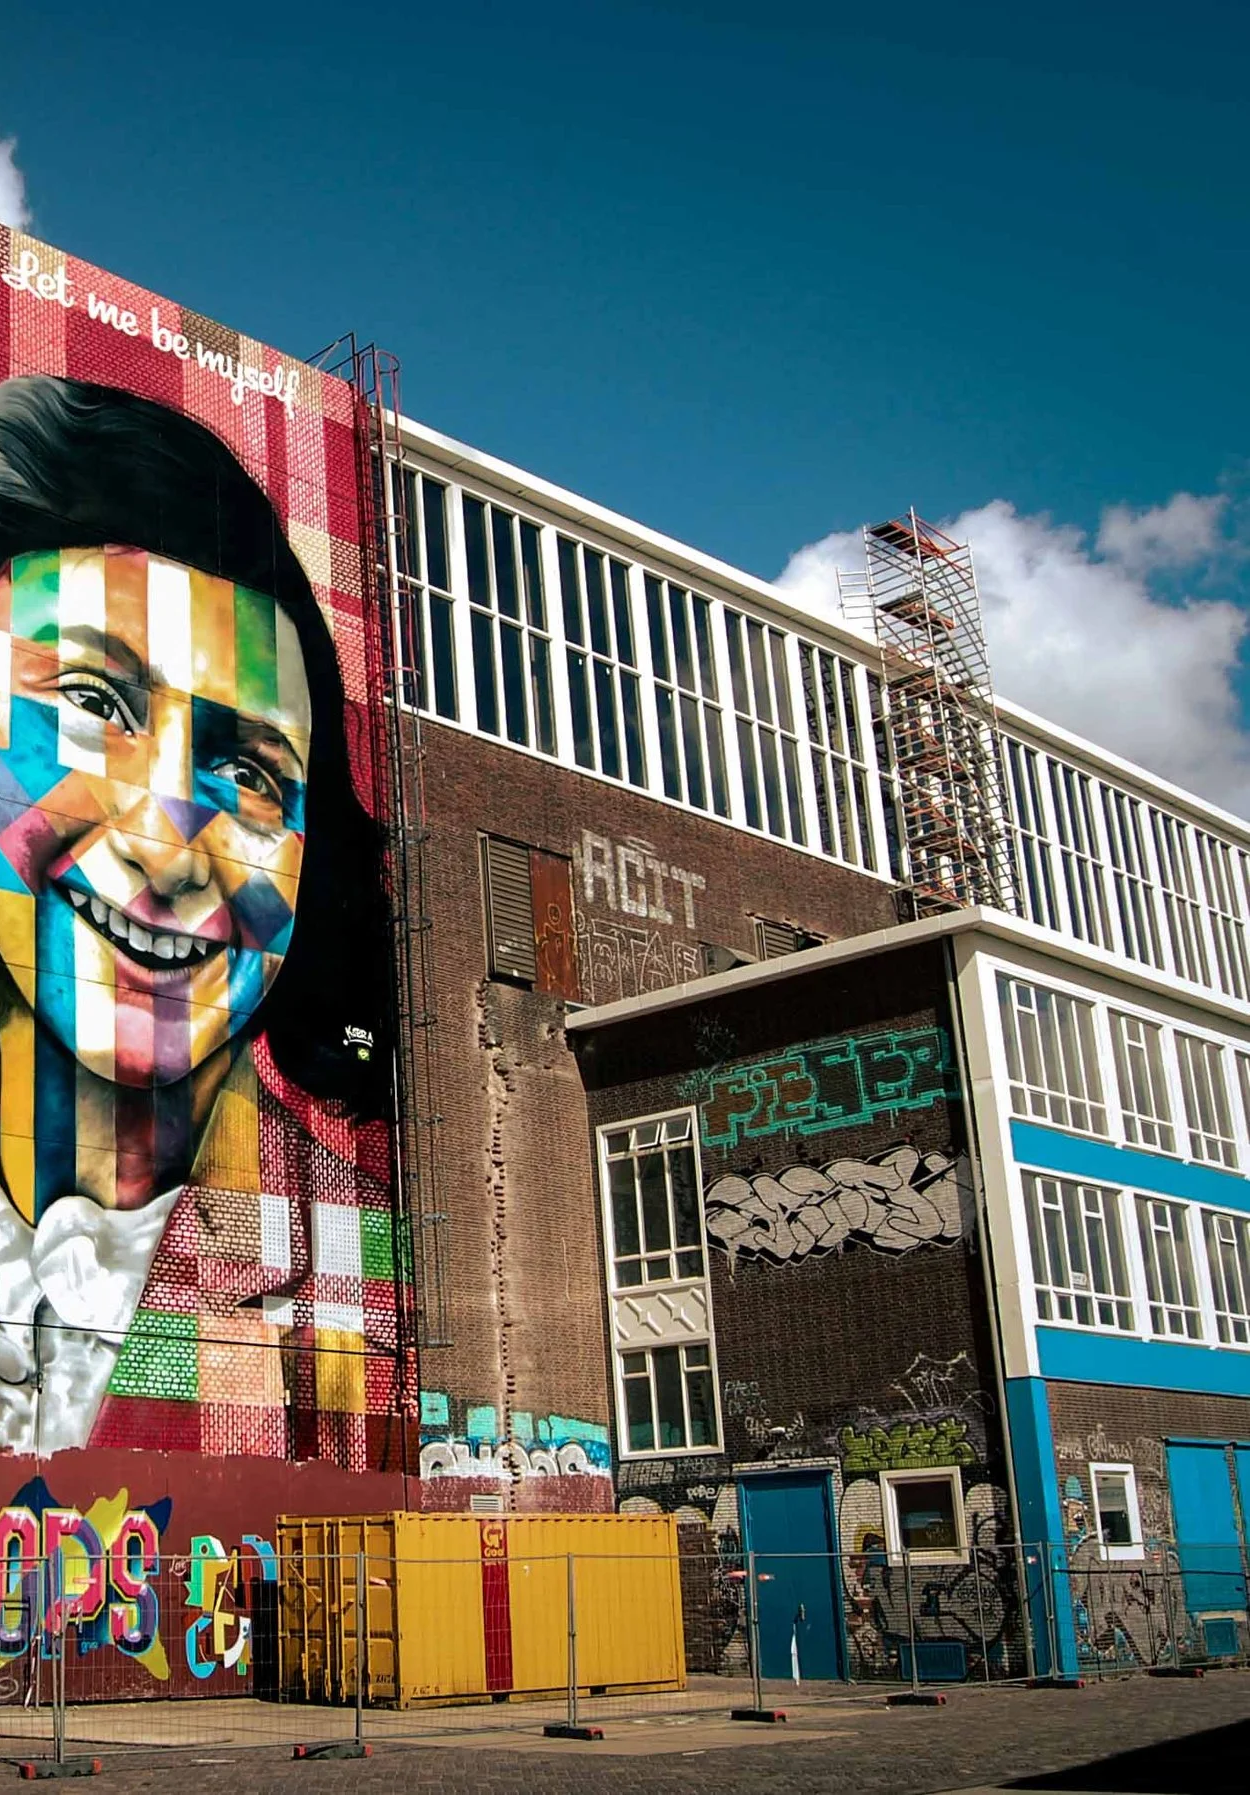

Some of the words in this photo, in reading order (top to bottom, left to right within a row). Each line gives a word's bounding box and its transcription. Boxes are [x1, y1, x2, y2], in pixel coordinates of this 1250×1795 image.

[1, 250, 74, 309] Let
[88, 292, 140, 337] me
[151, 307, 191, 361] be
[196, 341, 302, 419] myself
